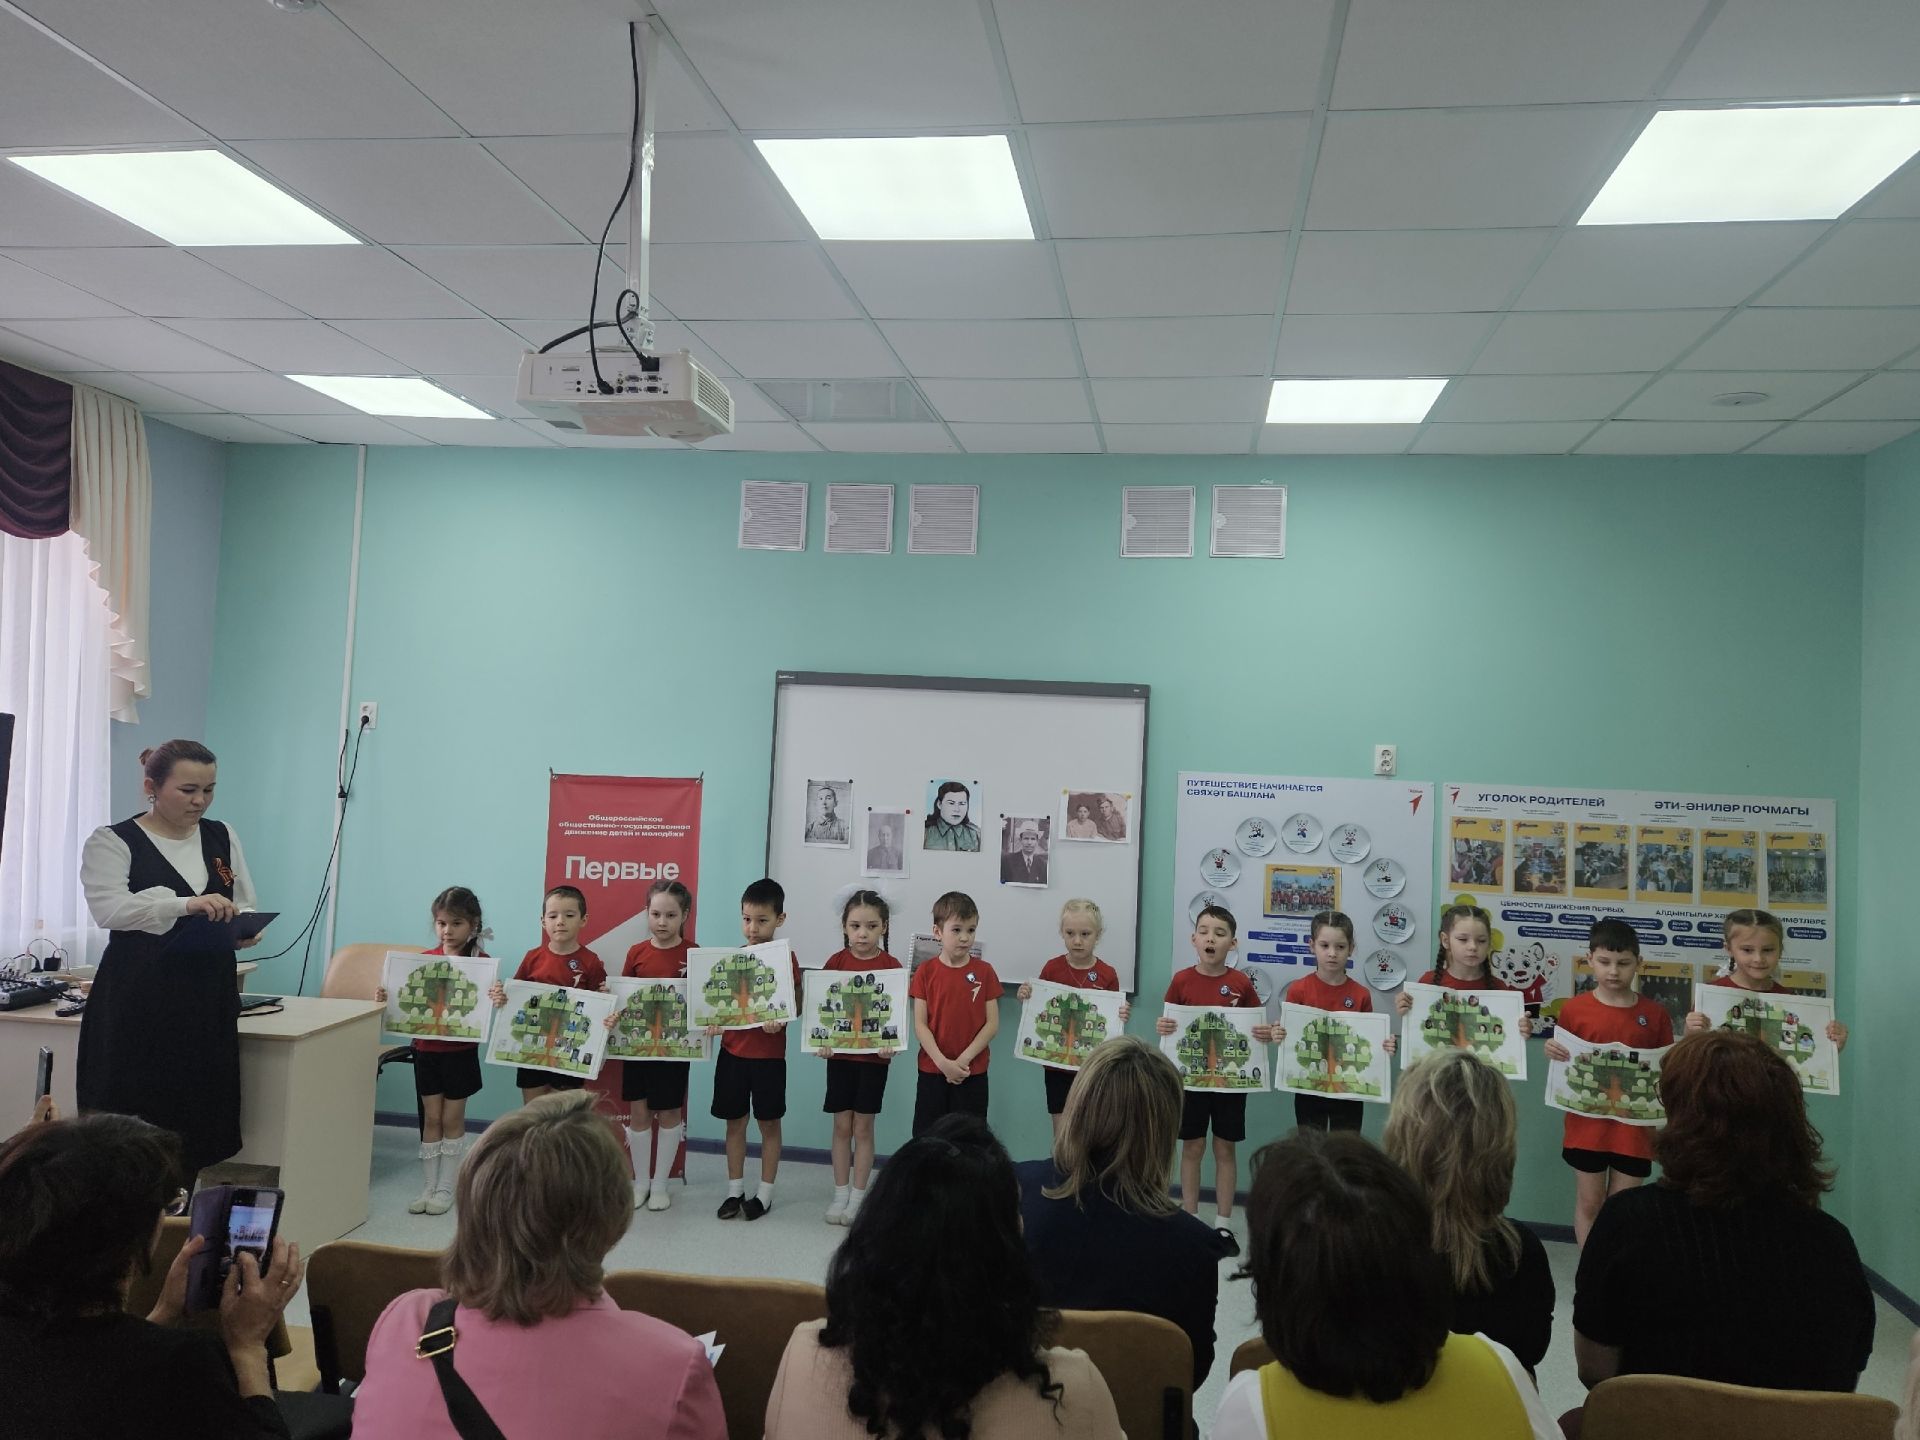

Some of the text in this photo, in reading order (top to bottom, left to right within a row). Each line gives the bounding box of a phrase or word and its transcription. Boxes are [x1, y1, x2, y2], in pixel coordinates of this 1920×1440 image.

[1187, 780, 1323, 792] ПУТЕШЕСТВИЕ НАЧИНАЕТСЯ
[1227, 790, 1276, 799] БАШЛАНА
[1478, 793, 1605, 807] УГОЛОК РОДИТЕЛЕЙ
[1742, 804, 1810, 816] ПОЧМАГЫ
[565, 855, 680, 887] Первые
[1500, 901, 1625, 914] ЦЕННОСТИ ДВИЖЕНИЯ ПЕРВЫХ
